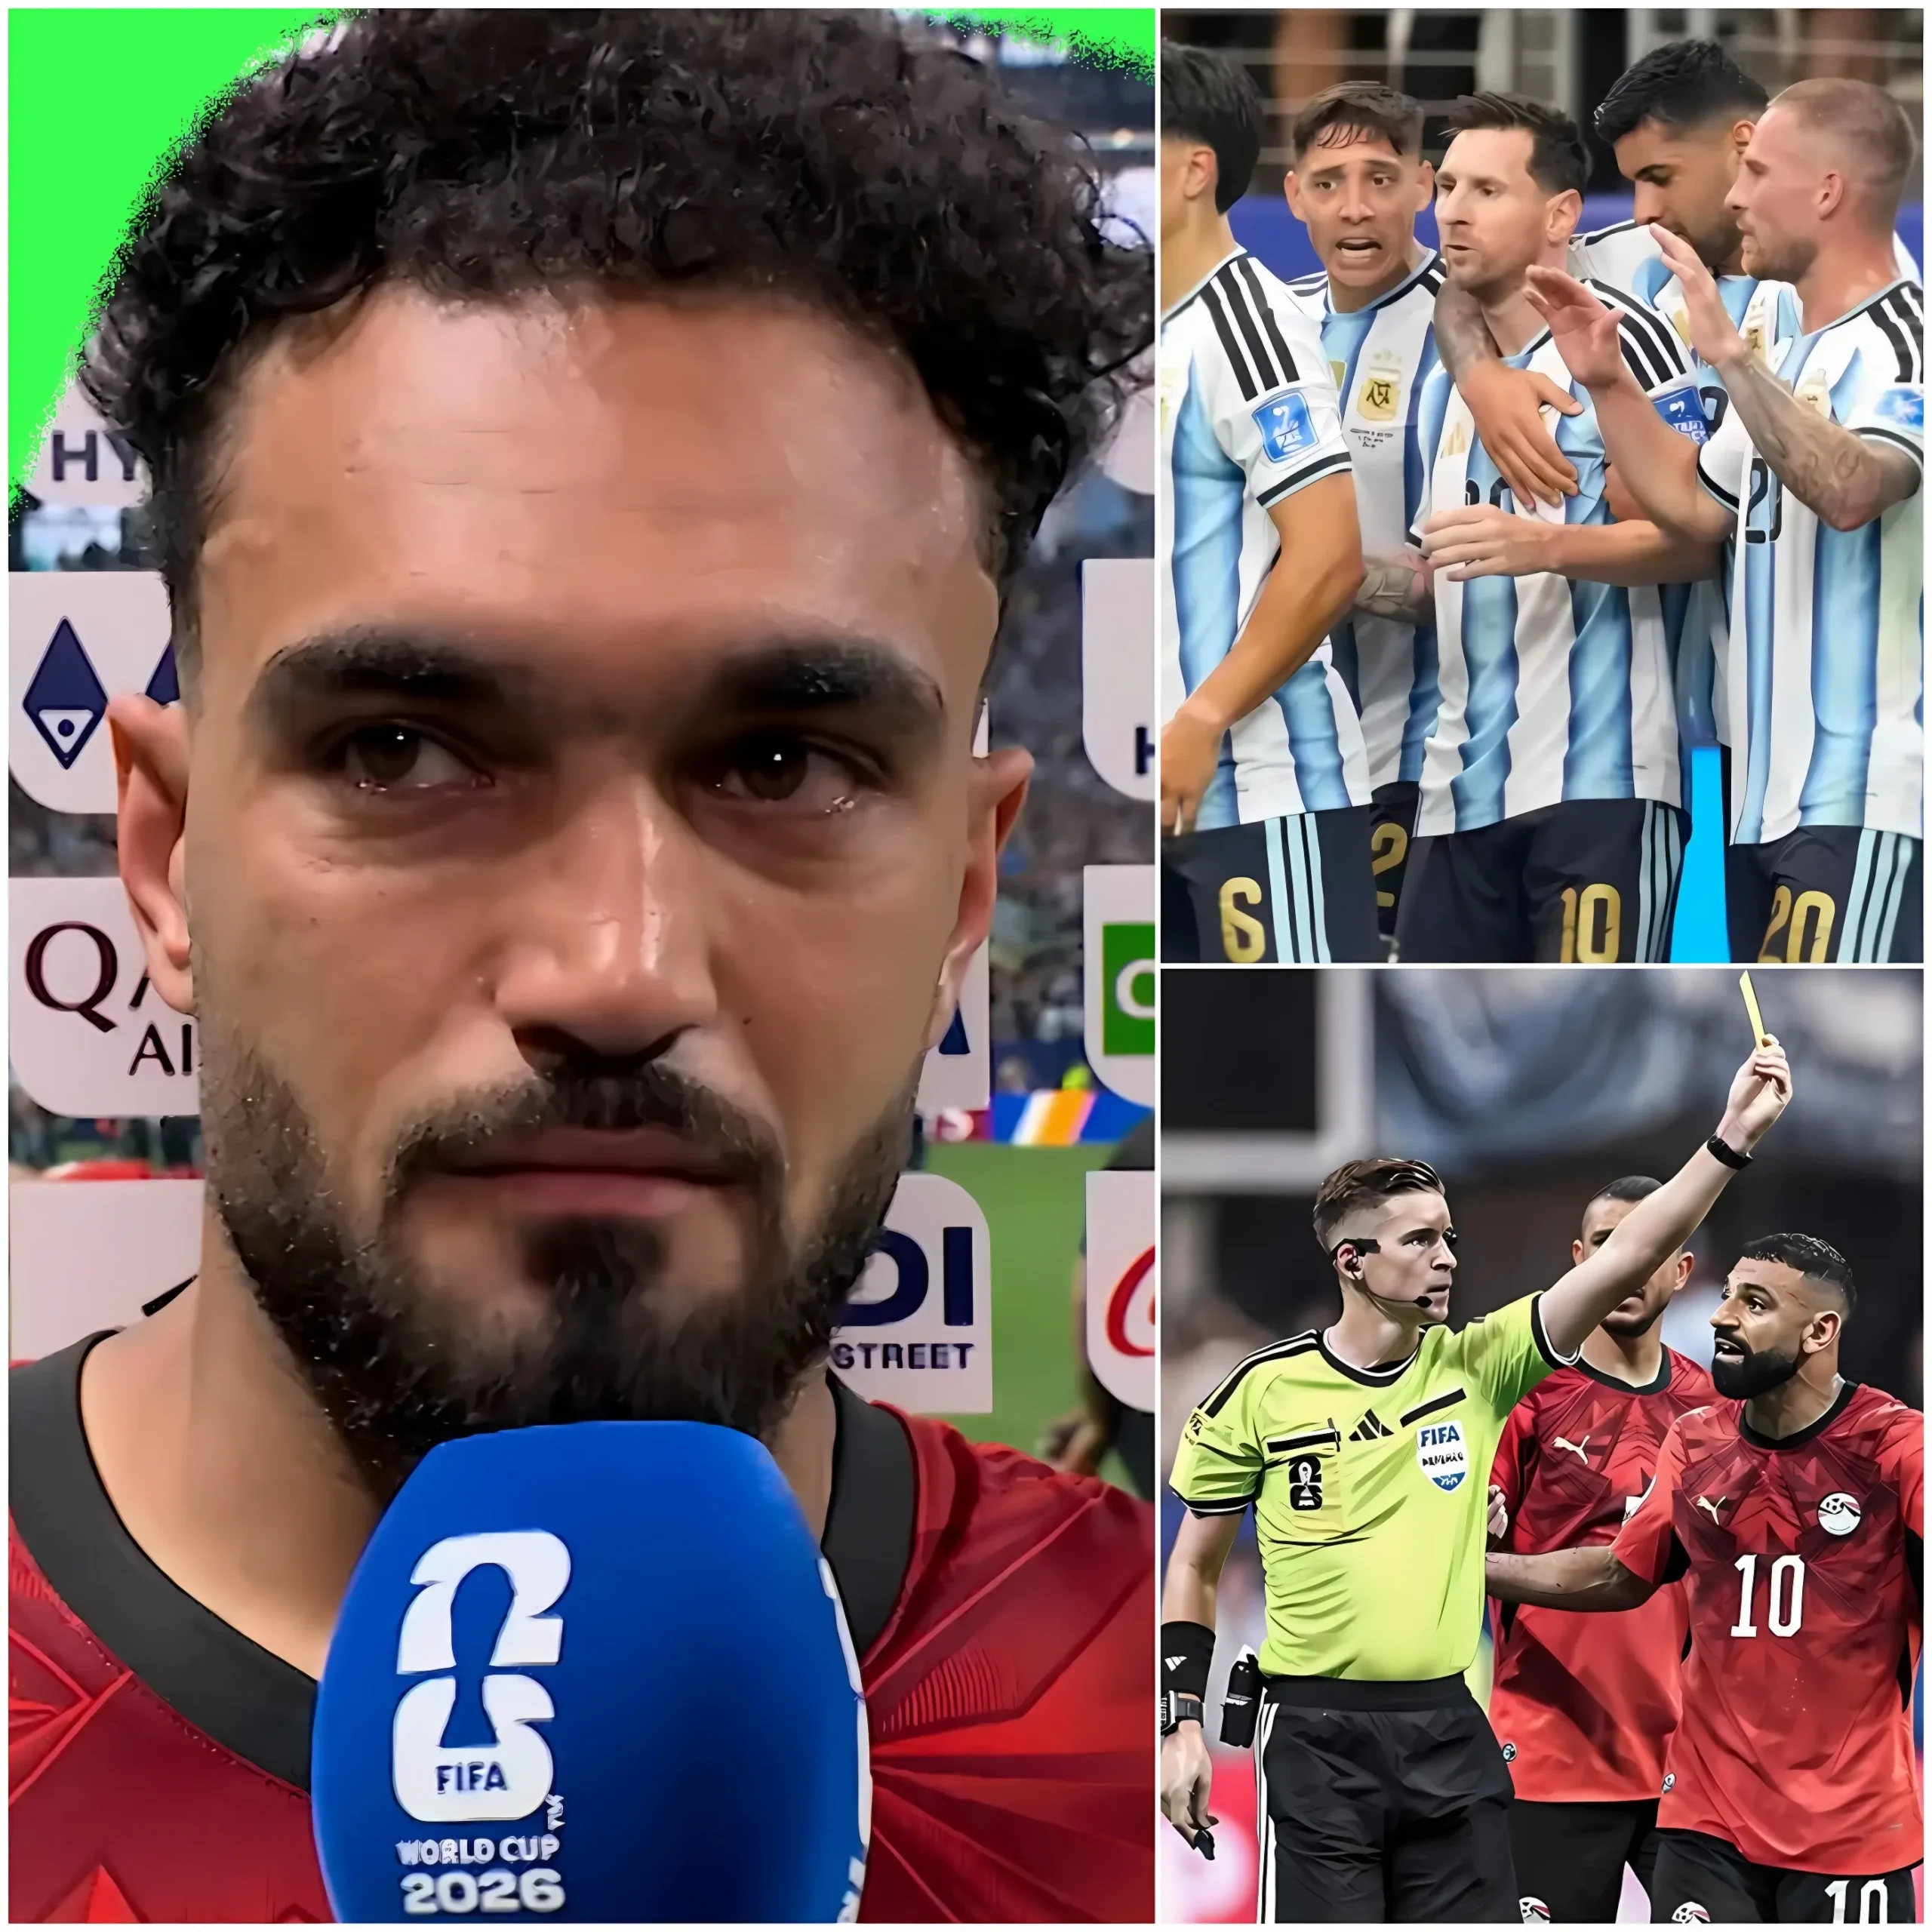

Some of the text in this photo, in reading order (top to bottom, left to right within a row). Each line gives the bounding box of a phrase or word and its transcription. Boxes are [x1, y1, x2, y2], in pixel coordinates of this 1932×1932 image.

[1219, 877, 1266, 963] 6
[1560, 883, 1621, 963] 10
[1758, 885, 1835, 963] 20
[834, 1343, 974, 1370] STREET
[1420, 1425, 1460, 1447] FIFA
[1730, 1554, 1806, 1638] 10
[435, 1761, 511, 1794] FIFA
[395, 1833, 560, 1865] WORLD CUP
[400, 1868, 565, 1915] 2026
[1824, 1878, 1888, 1924] 10
